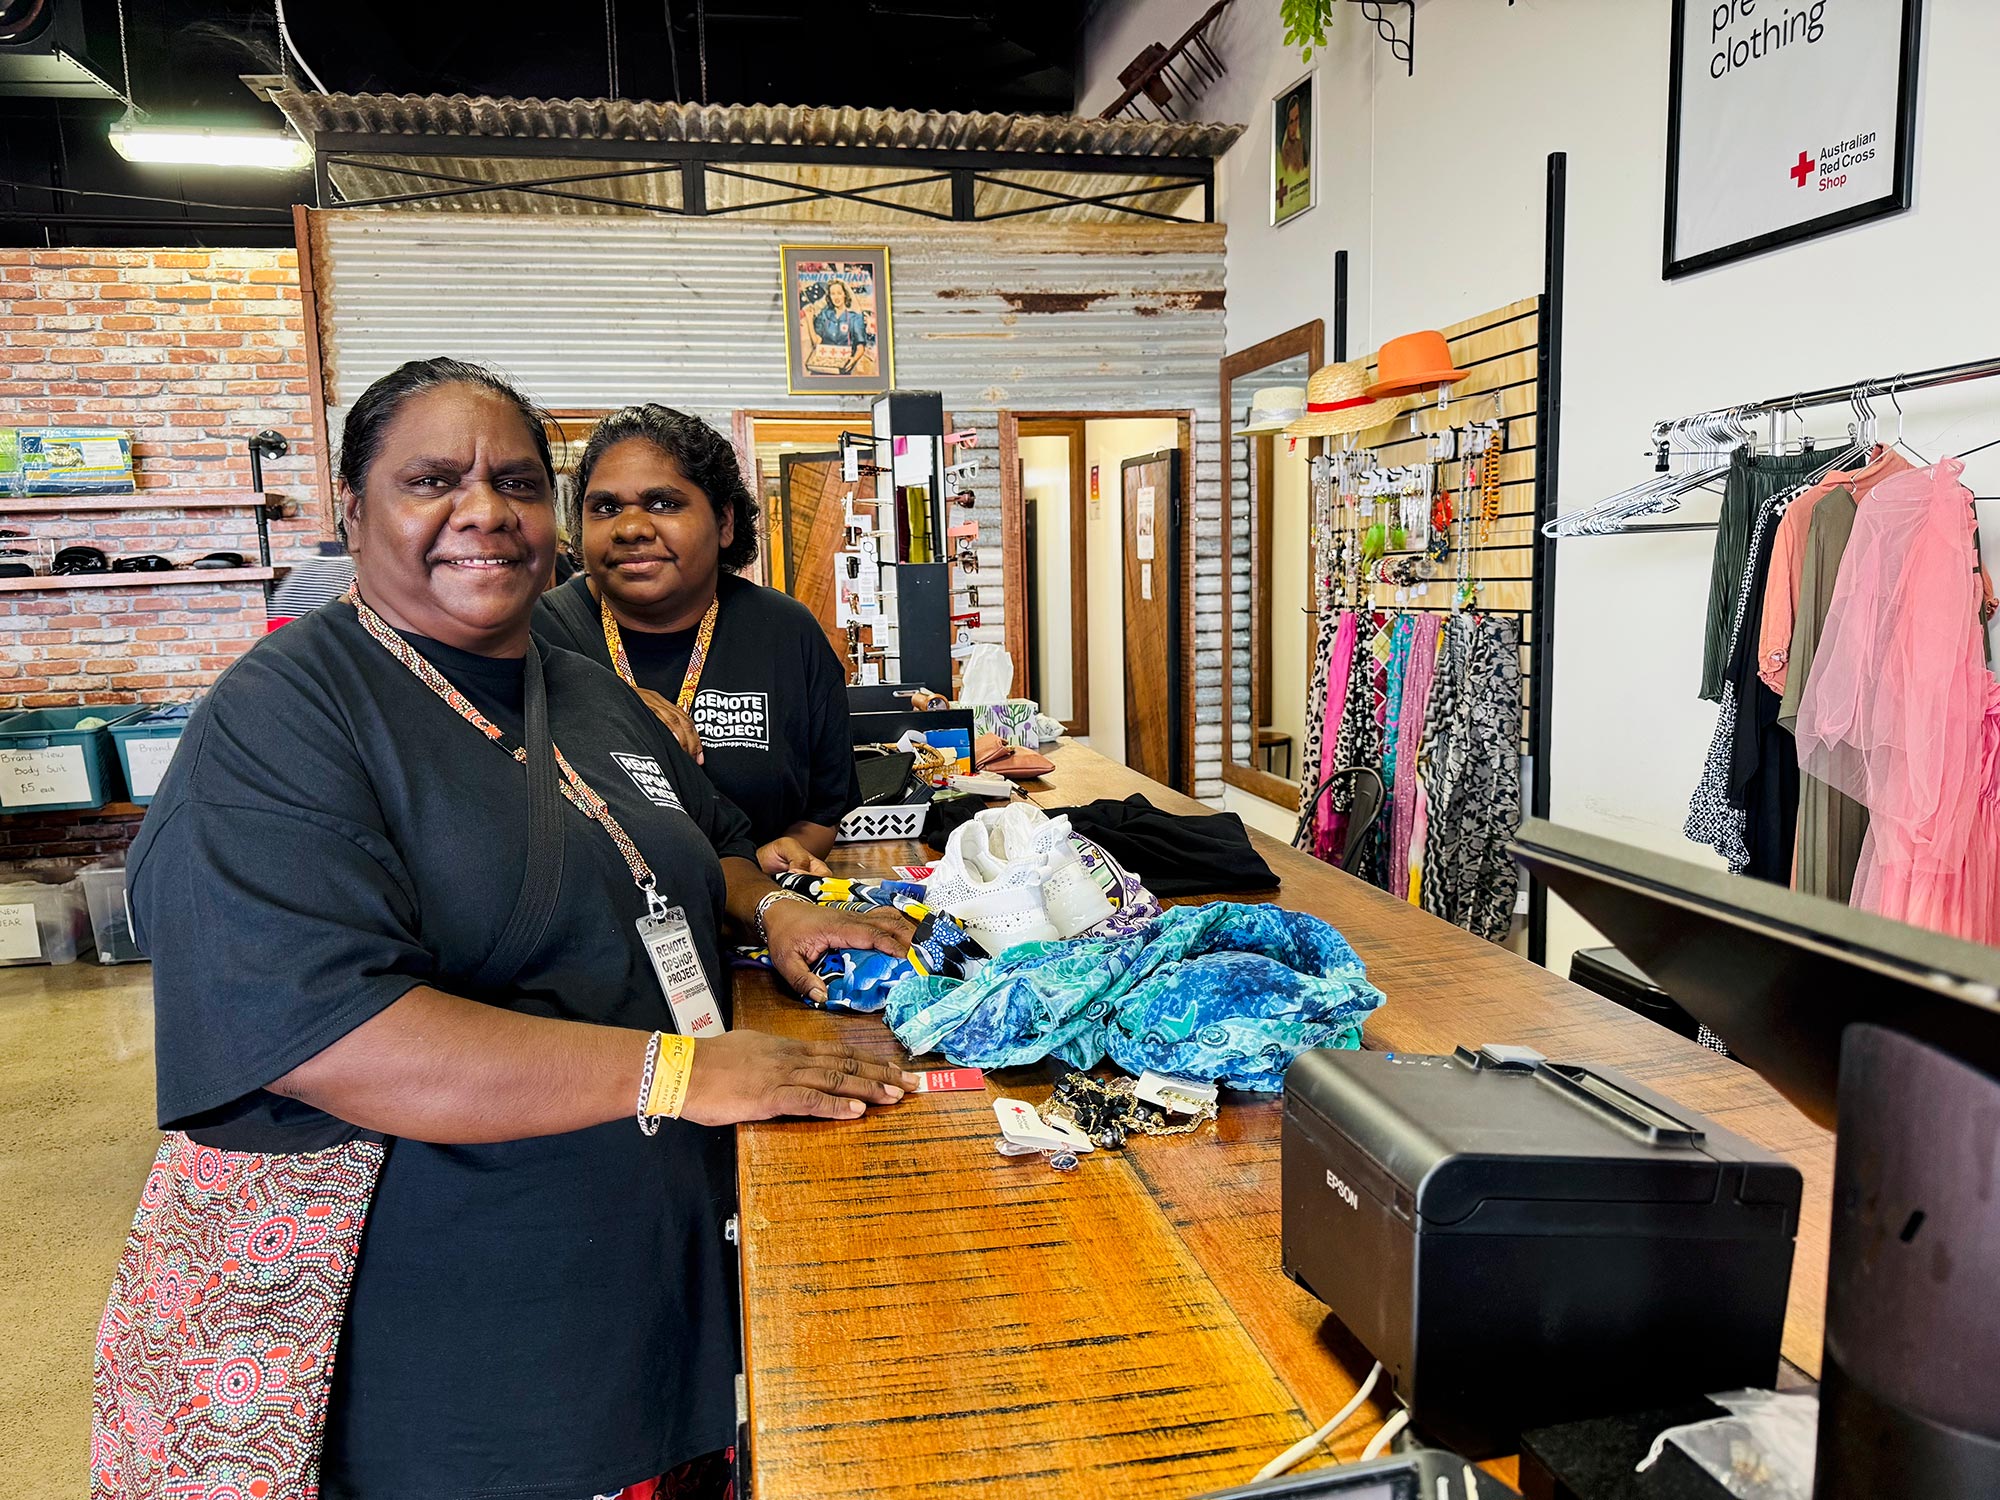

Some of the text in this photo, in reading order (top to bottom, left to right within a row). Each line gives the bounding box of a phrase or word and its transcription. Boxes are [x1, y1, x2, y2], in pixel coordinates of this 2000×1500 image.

[1710, 0, 1826, 79] clothing
[1820, 131, 1876, 161] Australian
[1820, 148, 1875, 176] Red Cross
[1819, 174, 1847, 192] Shop
[694, 693, 763, 711] REMOTE
[693, 708, 764, 725] OPSHOP
[695, 722, 764, 738] PROJECT
[139, 741, 172, 753] Brand
[0, 751, 65, 764] Brand New
[14, 764, 68, 777] Body Suit
[20, 782, 35, 794] $5
[656, 937, 690, 959] REMOTE
[661, 951, 694, 973] OPSHOP
[667, 964, 699, 986] PROJECT
[691, 1012, 713, 1032] ANNIE
[674, 1035, 683, 1057] OTEL
[1326, 1169, 1358, 1210] EPSON
